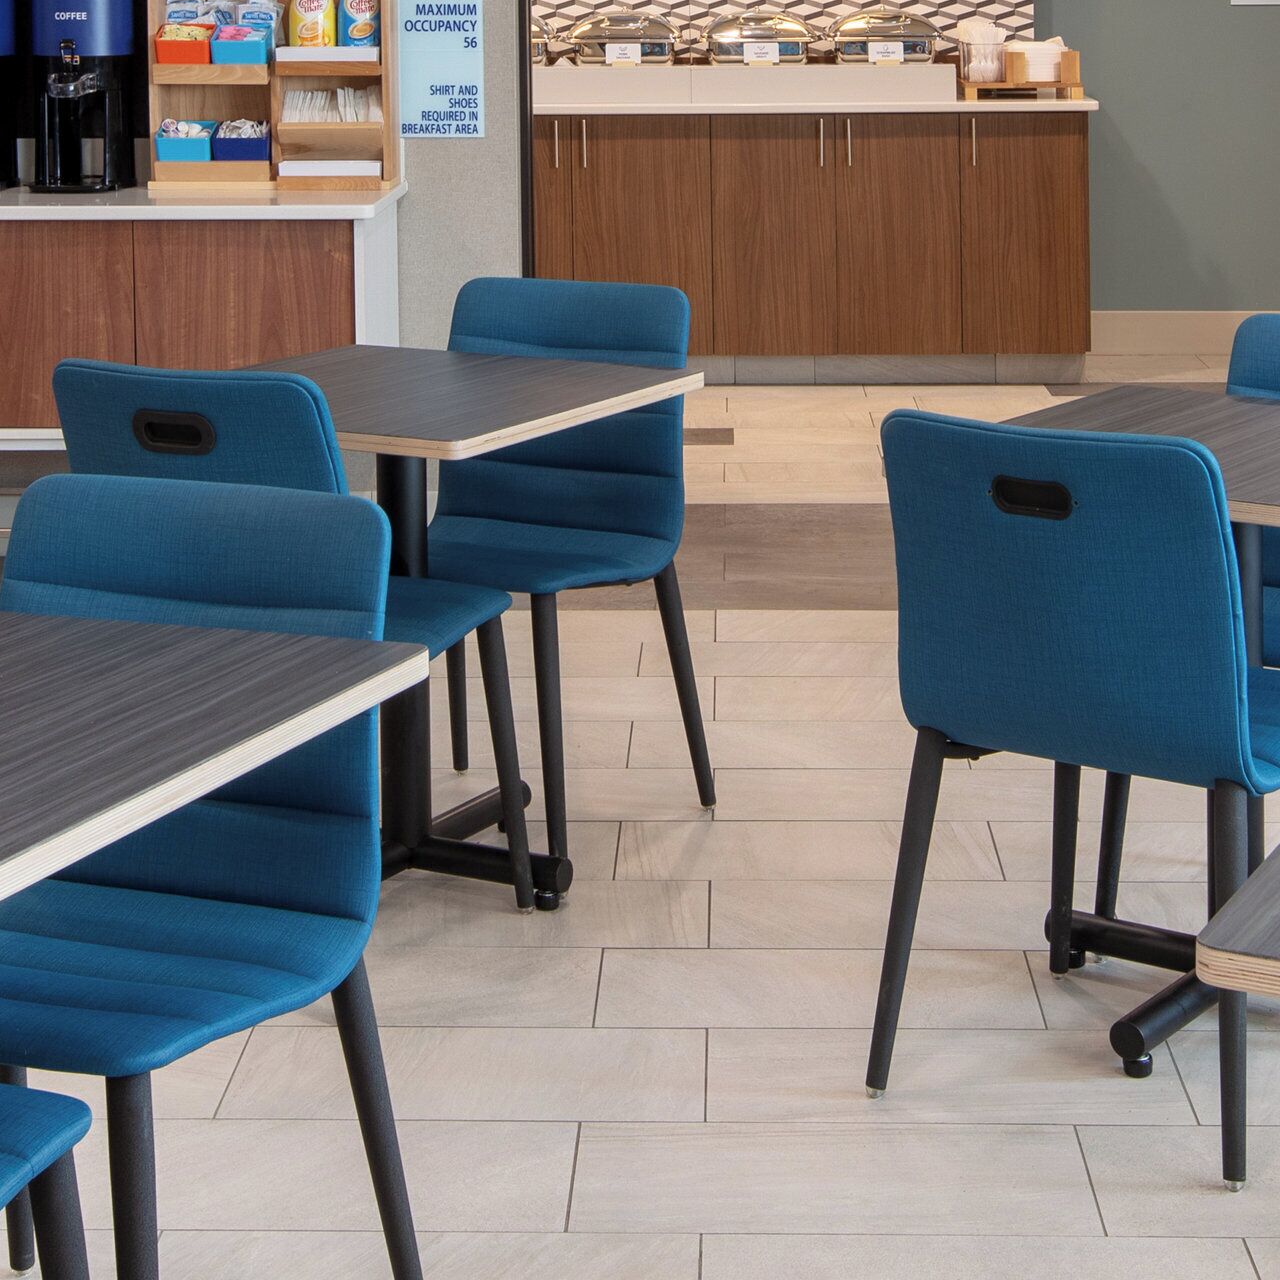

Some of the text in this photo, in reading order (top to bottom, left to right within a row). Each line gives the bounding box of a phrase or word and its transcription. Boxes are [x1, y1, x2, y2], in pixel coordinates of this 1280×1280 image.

[415, 3, 478, 16] MAXIMUM
[55, 12, 87, 21] COFFEE
[404, 19, 478, 32] OCCUPANCY
[463, 36, 478, 48] 56
[430, 85, 478, 96] SHIRT AND
[449, 98, 478, 109] SHOES
[421, 111, 478, 122] REQUIRED IN
[402, 124, 479, 134] BREAKFAST AREA
